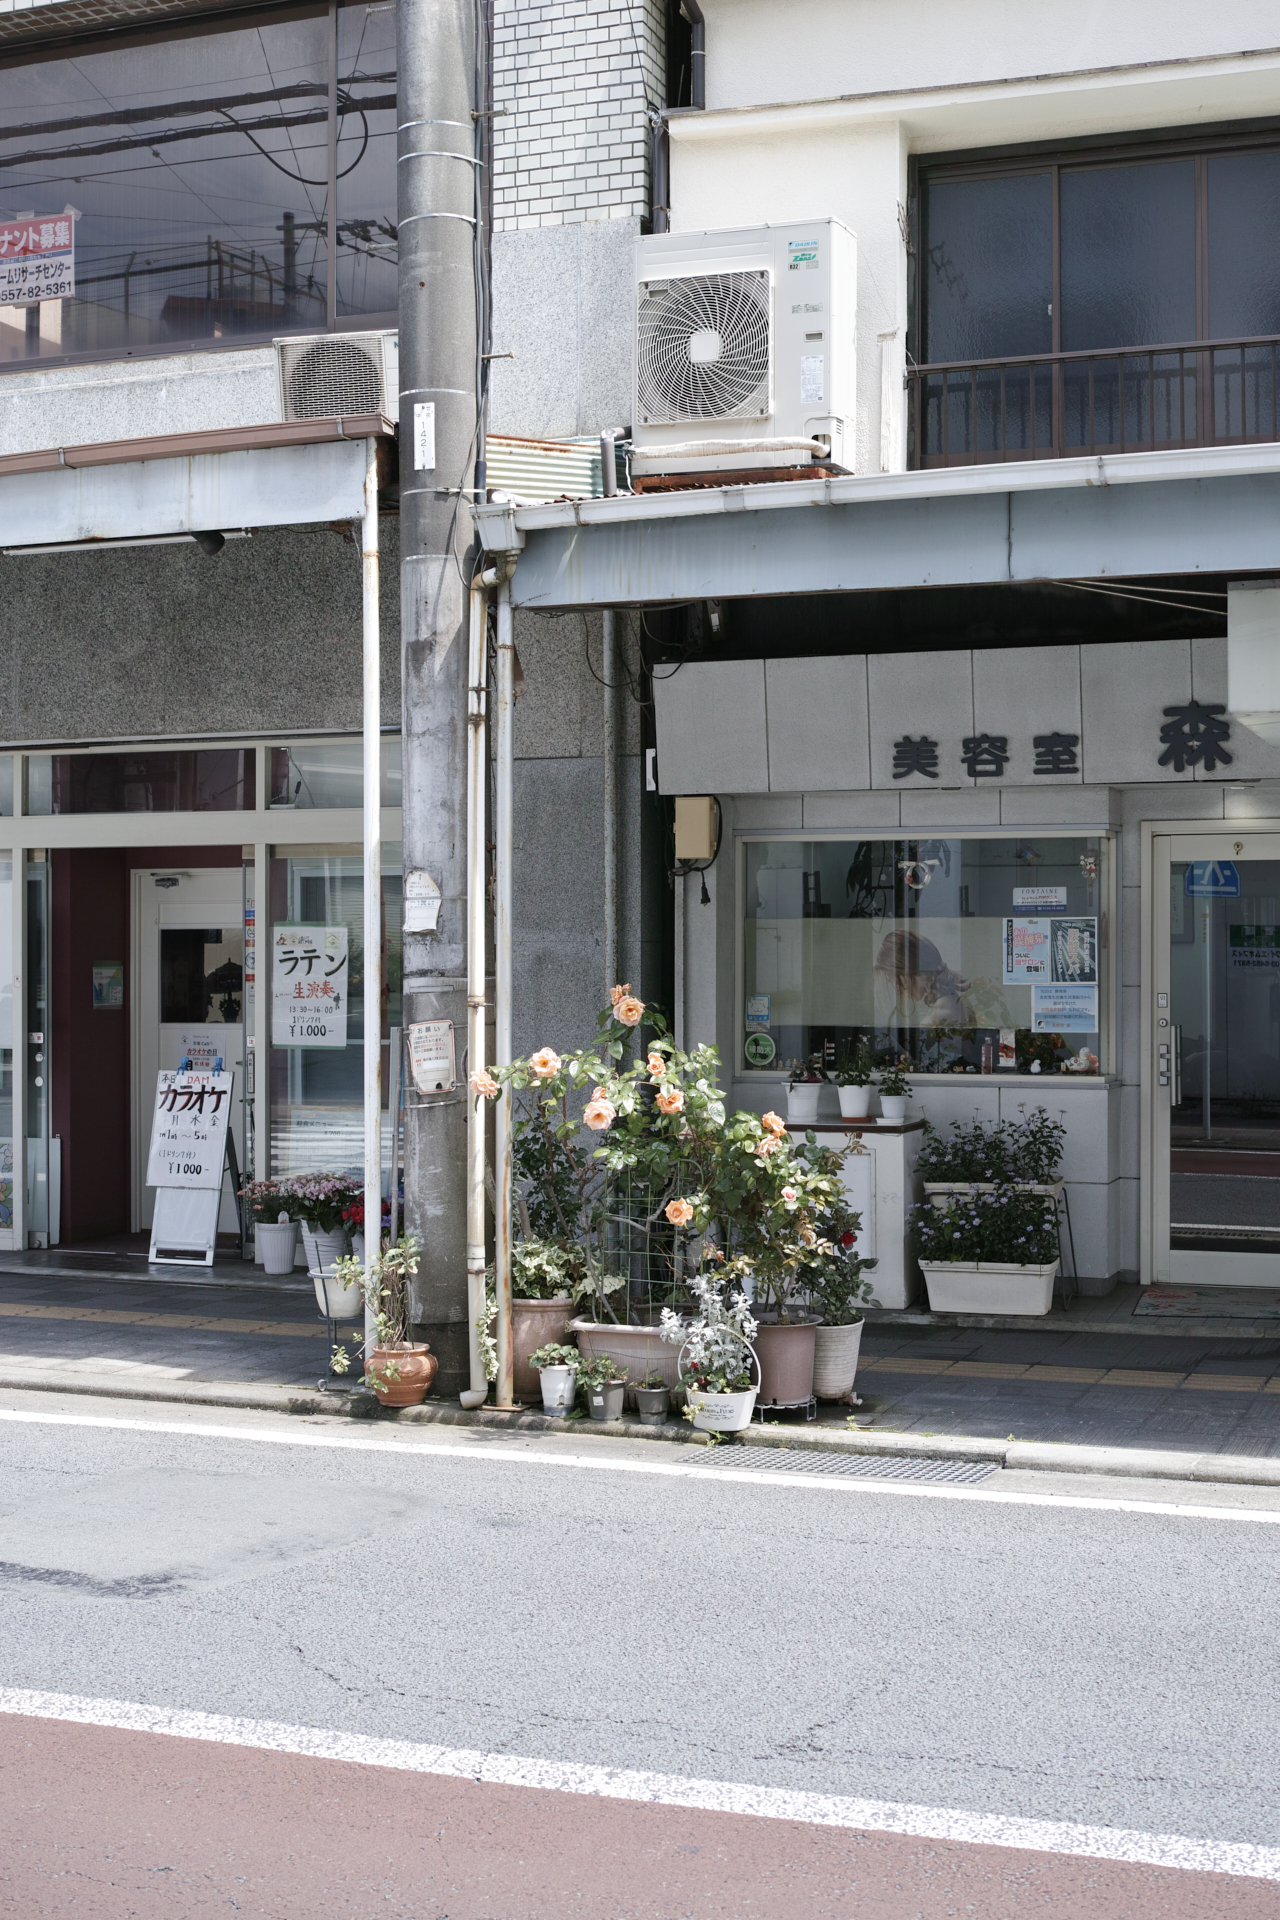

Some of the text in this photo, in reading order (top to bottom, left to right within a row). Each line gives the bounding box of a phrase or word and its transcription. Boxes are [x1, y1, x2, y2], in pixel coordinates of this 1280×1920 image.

[892, 700, 1233, 779] 美容室 森
[1014, 933, 1046, 947] 炭酸泉
[278, 948, 347, 977] ラテン
[292, 980, 336, 999] 生演奏
[417, 1026, 441, 1034] お願い
[187, 1076, 210, 1084] DAM
[158, 1084, 228, 1115] カラオケ
[172, 1114, 220, 1128] 月 水 金
